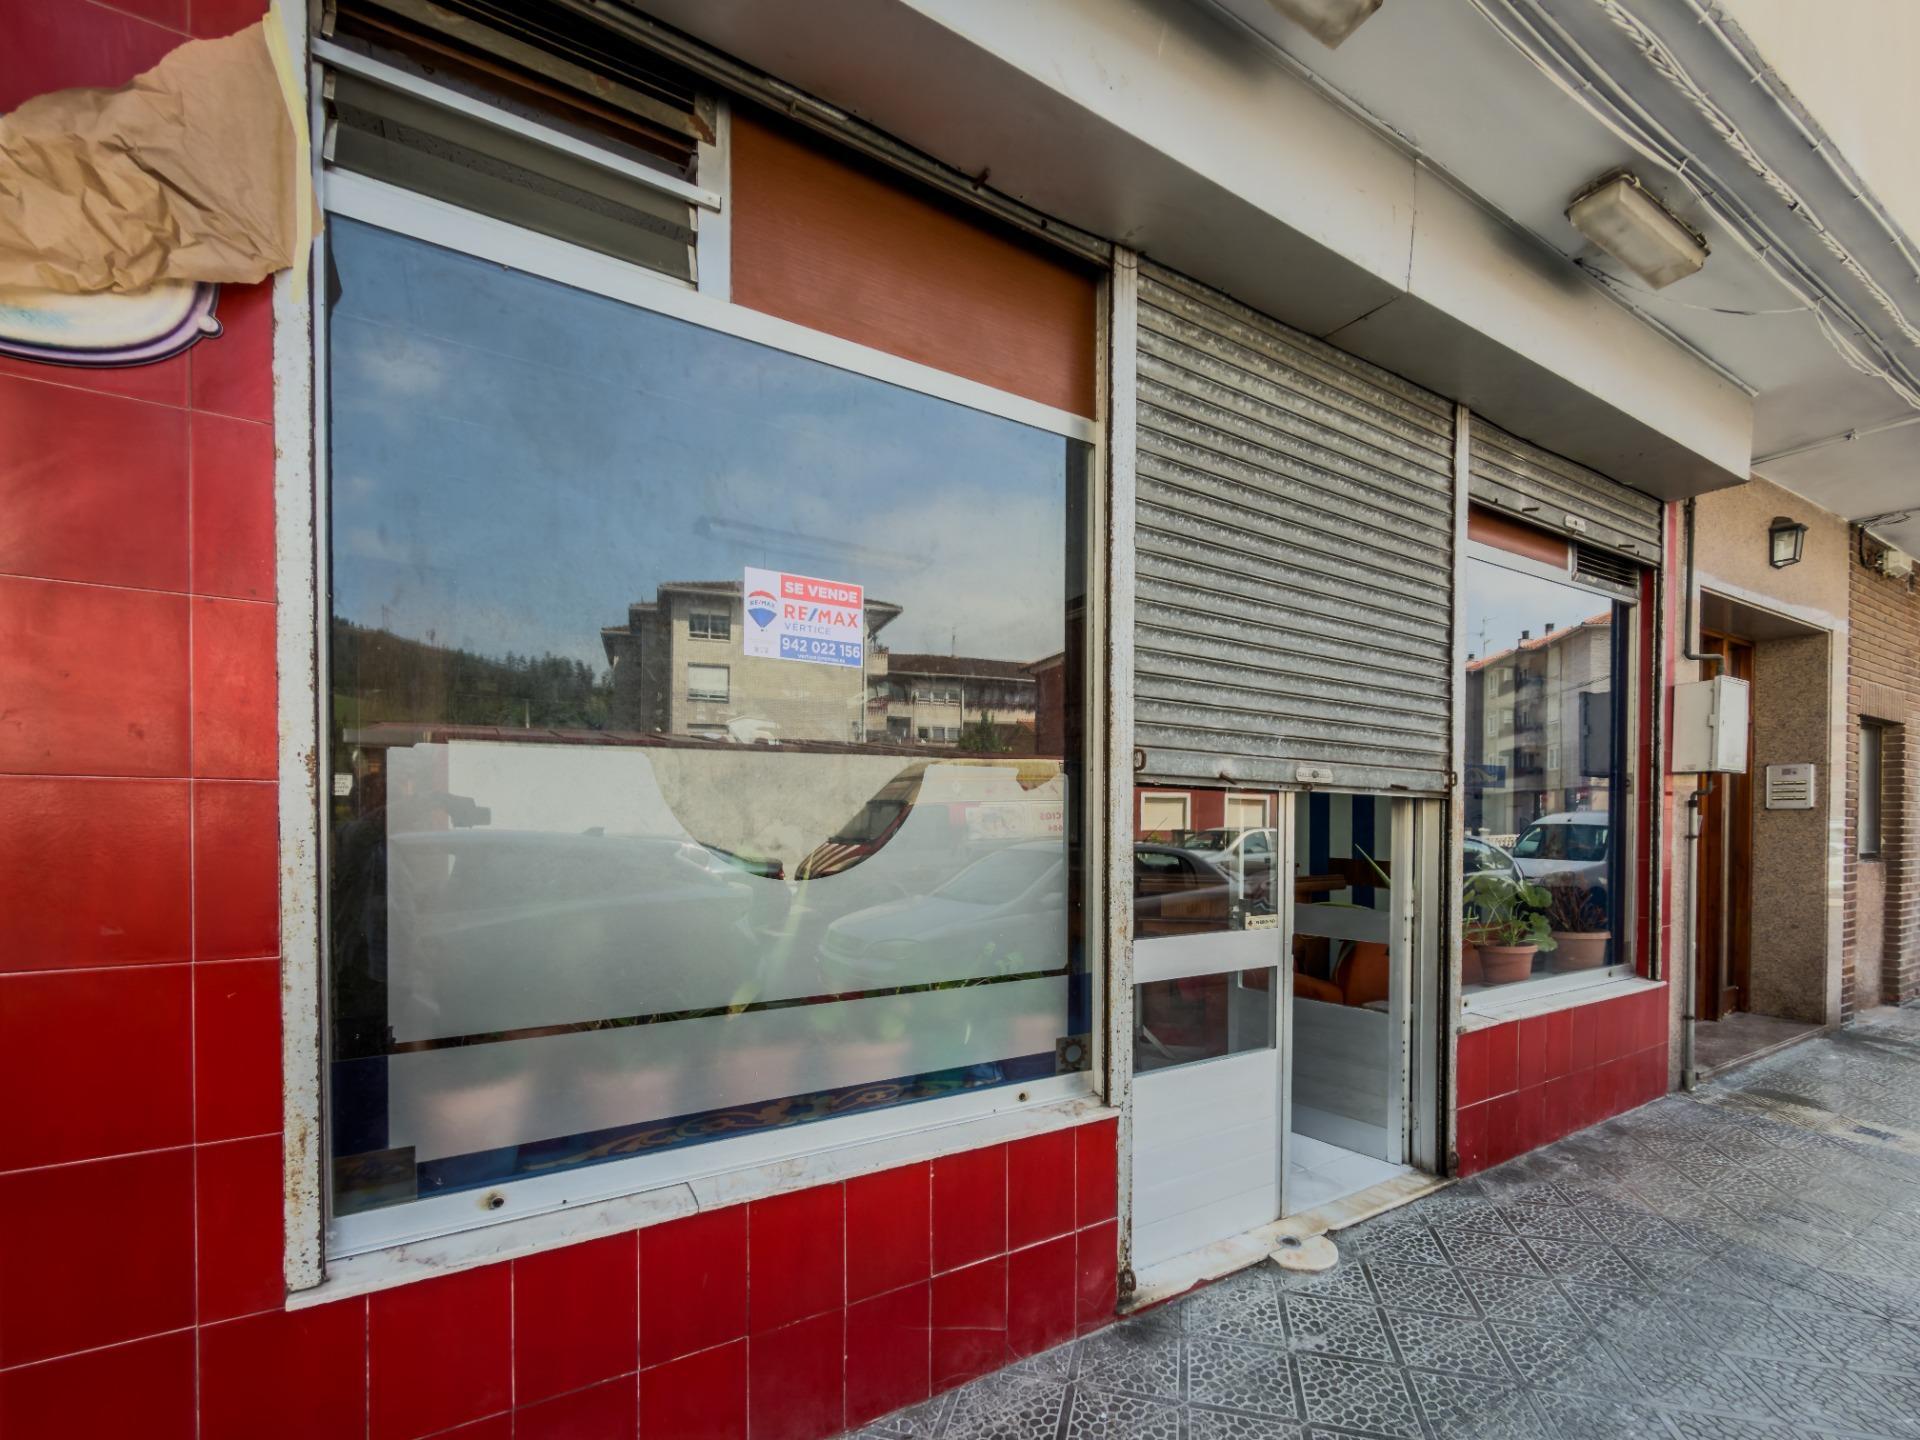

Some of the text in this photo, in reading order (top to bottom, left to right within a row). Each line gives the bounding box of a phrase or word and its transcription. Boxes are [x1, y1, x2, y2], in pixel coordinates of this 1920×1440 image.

[784, 581, 858, 603] SE VENDE
[784, 603, 858, 628] RE/MAX
[782, 637, 808, 652] 942
[811, 642, 836, 656] 022
[840, 644, 861, 658] 156
